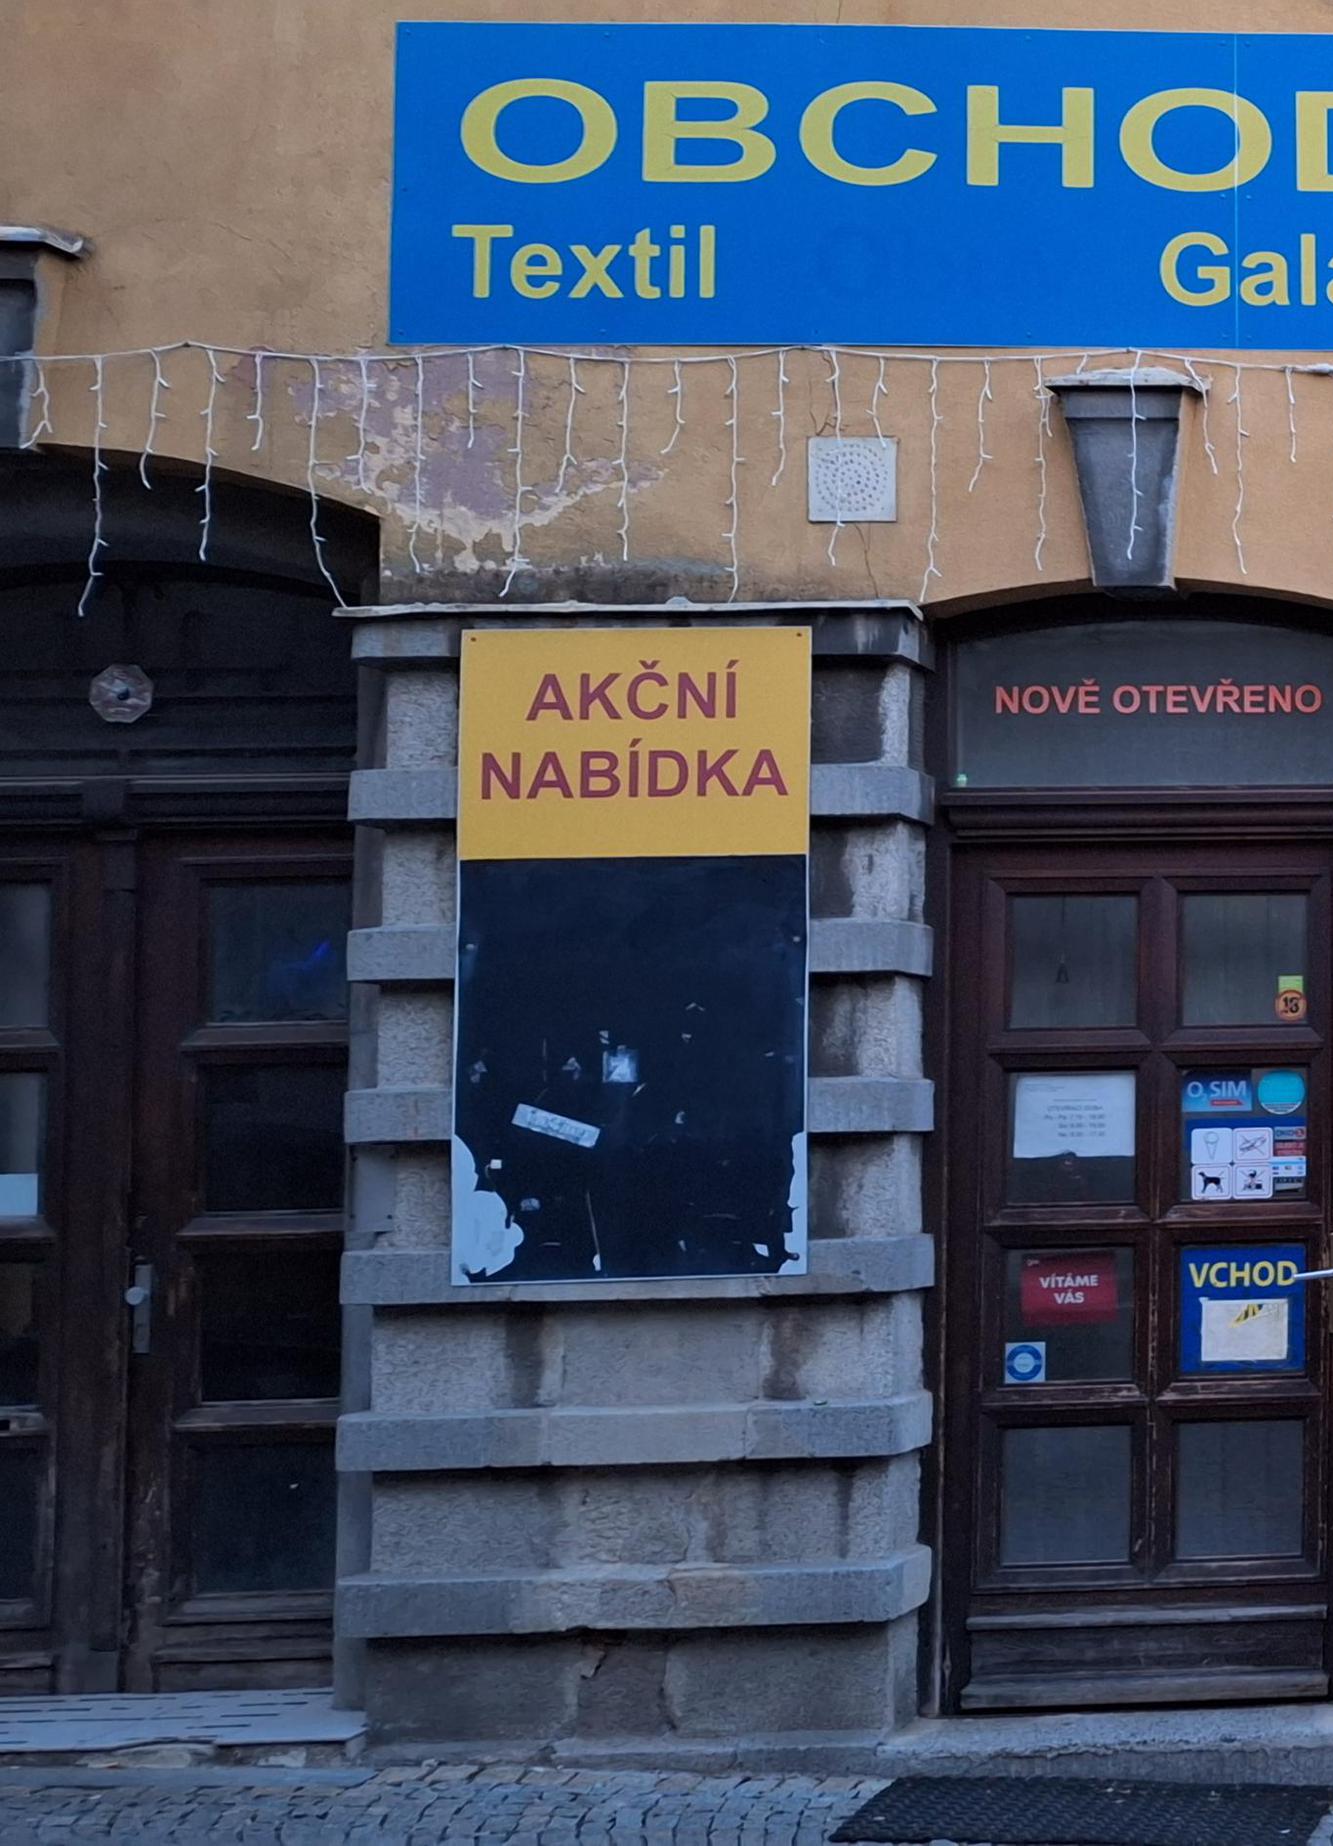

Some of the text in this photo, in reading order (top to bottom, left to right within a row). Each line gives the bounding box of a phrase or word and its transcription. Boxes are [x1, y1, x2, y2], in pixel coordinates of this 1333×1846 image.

[451, 223, 716, 300] Textil
[526, 659, 739, 721] AKČNÍ
[994, 678, 1323, 715] NOVĚ OTEVŘENO
[480, 738, 789, 800] NABÍDKA
[1209, 1080, 1247, 1097] SIM
[1039, 1273, 1099, 1288] VÍTÁME
[1188, 1261, 1298, 1288] VCHOD
[1053, 1289, 1085, 1304] VÁS
